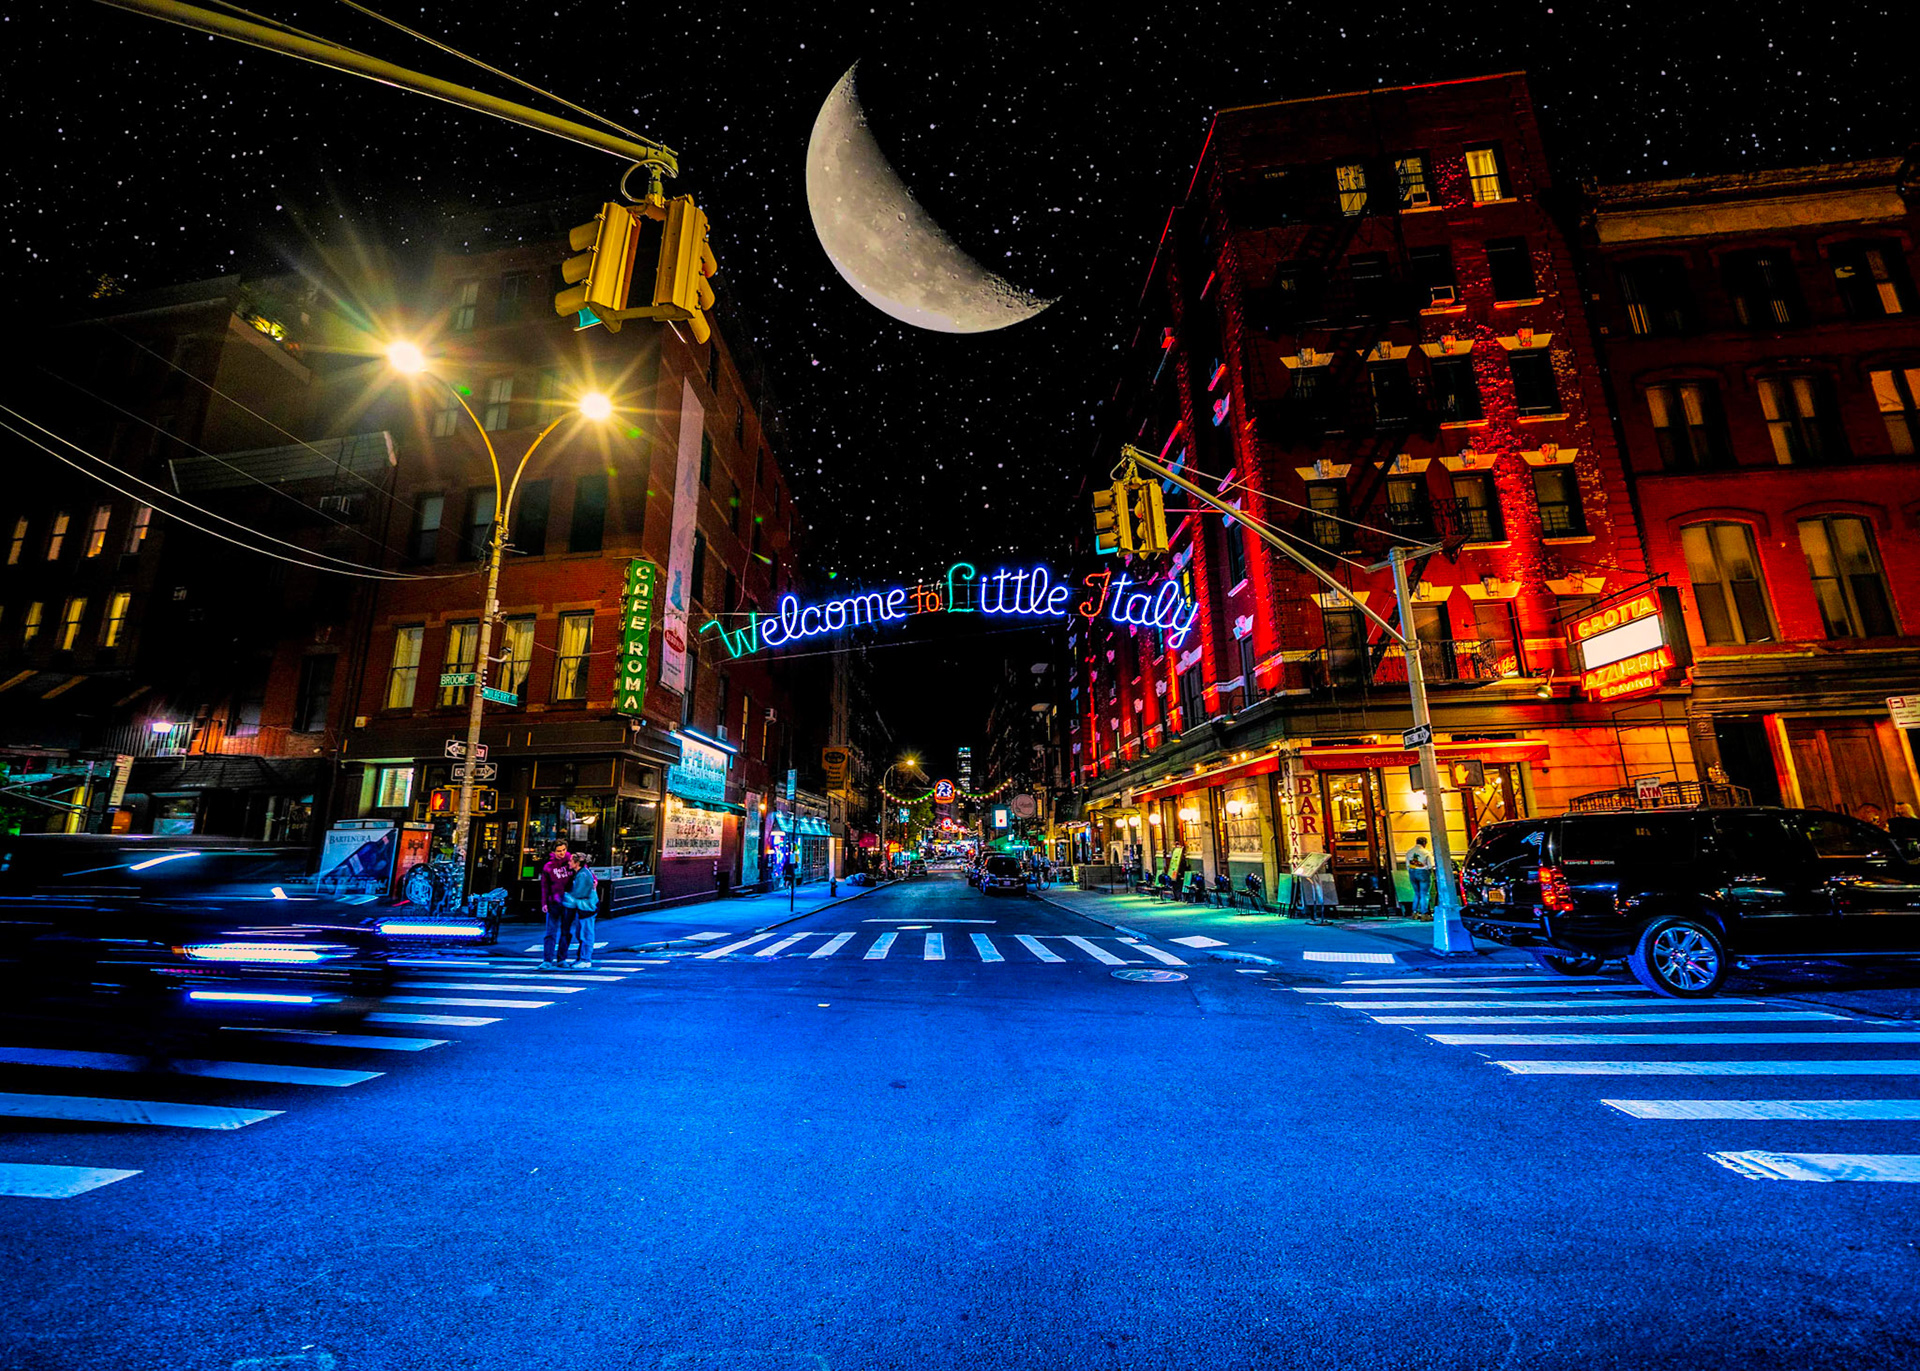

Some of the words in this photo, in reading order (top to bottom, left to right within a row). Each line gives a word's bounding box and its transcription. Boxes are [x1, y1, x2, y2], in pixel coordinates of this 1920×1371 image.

[630, 565, 651, 630] CAFE
[700, 588, 905, 658] Welcome
[910, 583, 940, 611] to
[947, 562, 1068, 615] Little
[1080, 572, 1199, 648] Italy
[1577, 596, 1658, 638] GROTTA
[441, 674, 469, 686] BROOME
[623, 641, 643, 710] ROMA
[1583, 649, 1674, 691] AZZURRA
[1406, 734, 1415, 745] ONE
[1417, 730, 1427, 741] WAY
[1363, 755, 1395, 766] Grotta
[1297, 777, 1318, 834] BAR
[1640, 786, 1662, 798] ATM
[329, 834, 372, 844] BARTENURA
